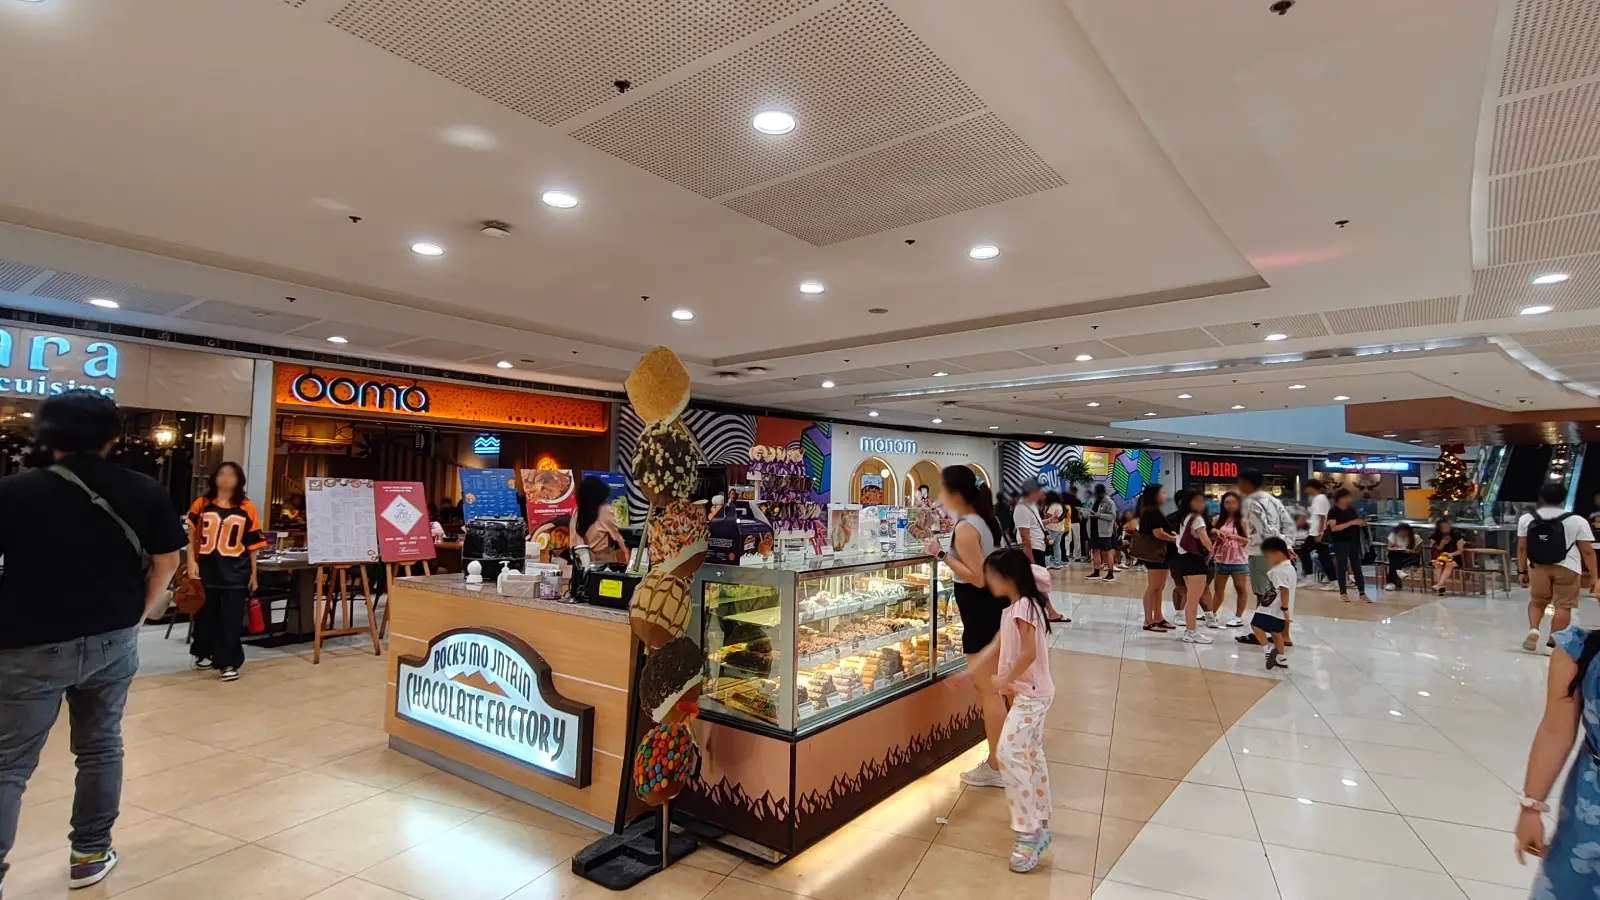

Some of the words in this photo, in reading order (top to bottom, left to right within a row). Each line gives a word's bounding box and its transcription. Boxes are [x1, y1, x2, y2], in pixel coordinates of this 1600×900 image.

[292, 369, 429, 412] ooma
[860, 436, 918, 455] manam
[1190, 461, 1210, 476] BAD
[1212, 462, 1237, 477] BIRD
[433, 641, 467, 673] ROCKY
[406, 672, 484, 729] CHOCOLATE
[486, 700, 566, 762] FACTORY
